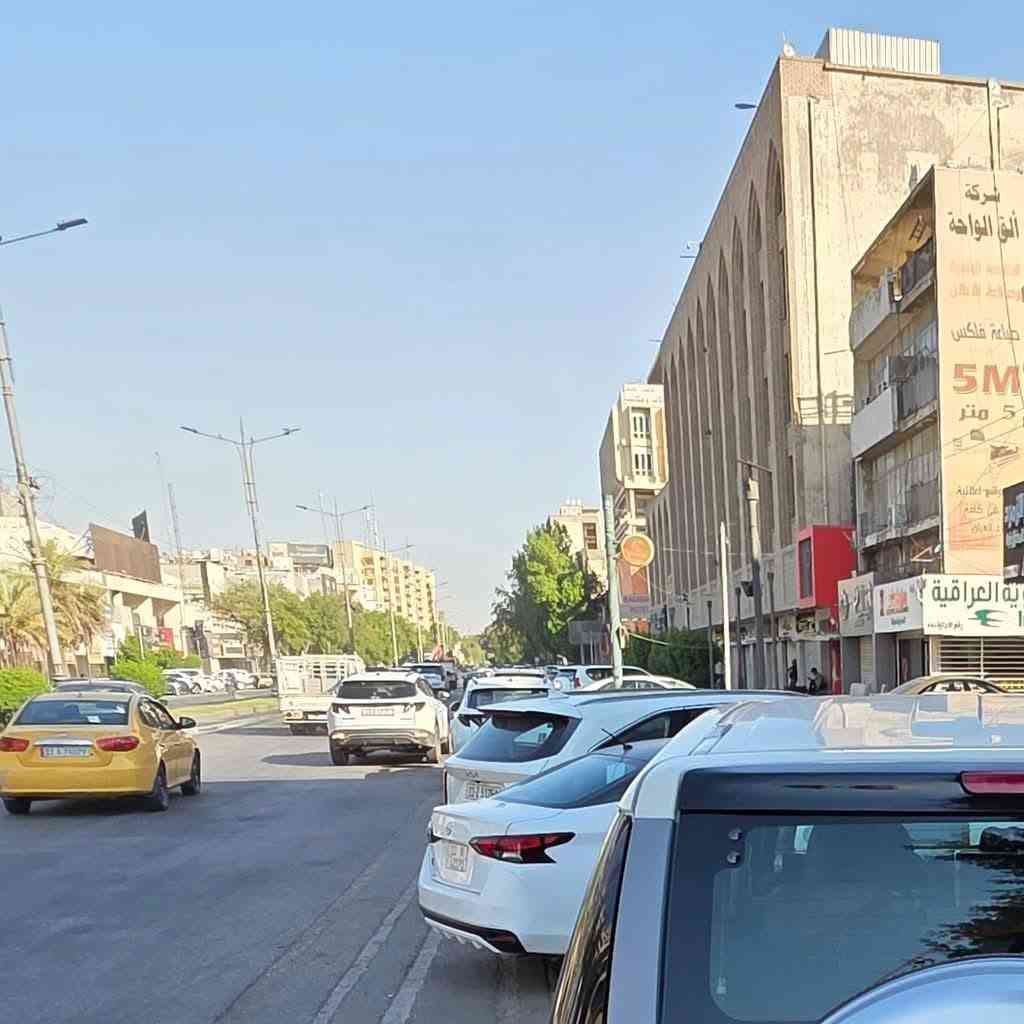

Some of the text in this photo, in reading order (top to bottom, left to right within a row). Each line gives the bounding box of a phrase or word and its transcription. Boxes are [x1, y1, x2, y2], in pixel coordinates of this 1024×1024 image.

[964, 184, 1000, 206] شركة
[948, 211, 993, 242] الواحة
[950, 321, 987, 343] فلكس
[952, 363, 1020, 394] 5M
[958, 402, 1016, 422] 5 متر
[931, 579, 999, 609] العراقية
